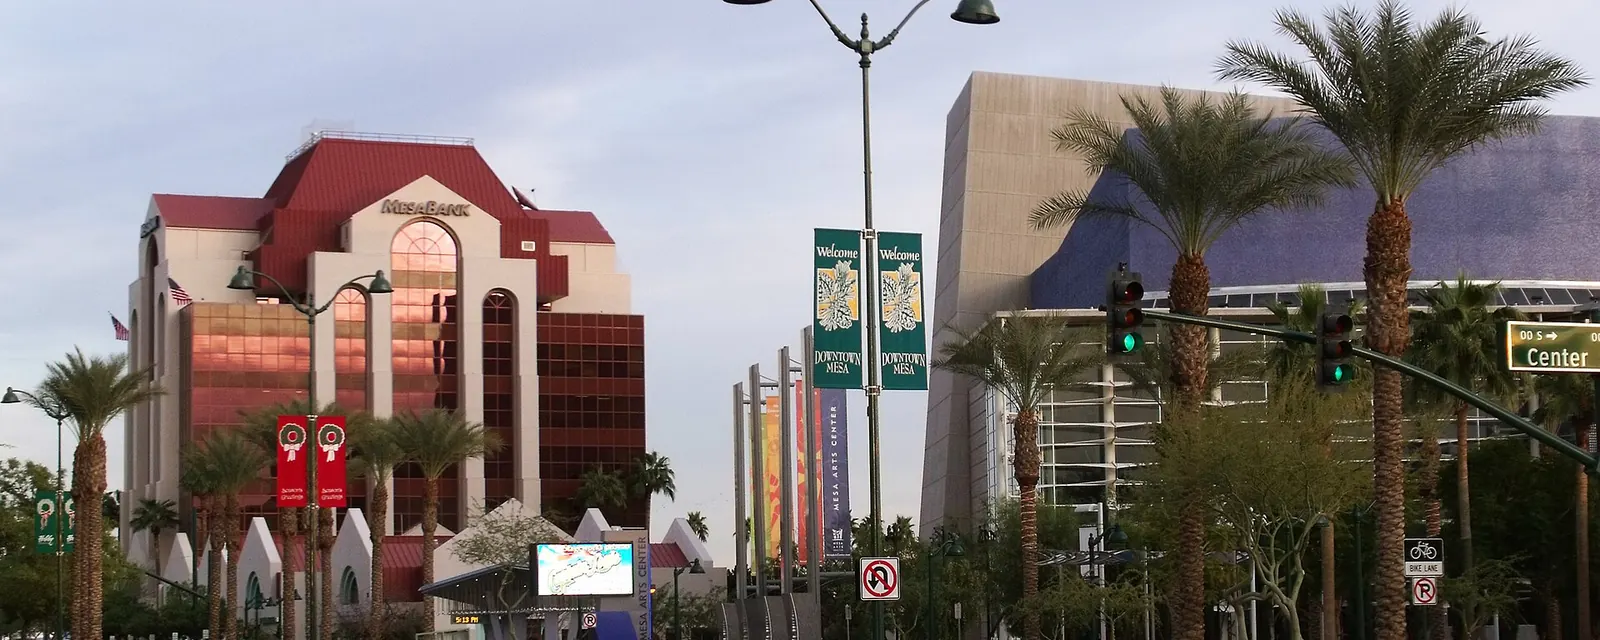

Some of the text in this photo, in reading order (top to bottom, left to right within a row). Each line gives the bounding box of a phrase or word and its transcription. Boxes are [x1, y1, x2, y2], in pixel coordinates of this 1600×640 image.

[816, 243, 858, 259] Welcome
[879, 246, 920, 261] Welcome
[1520, 330, 1543, 340] 00 S
[1591, 332, 1600, 342] 0
[814, 350, 861, 366] DOWNTOWN
[882, 353, 926, 367] DOWNTOWN
[1527, 347, 1589, 367] Center
[826, 362, 849, 374] MESA
[893, 364, 915, 375] MESA
[830, 406, 840, 511] MESA ARTS CENTER
[1410, 564, 1422, 572] BIKE
[638, 536, 649, 640] MESA ARTS CENTER
